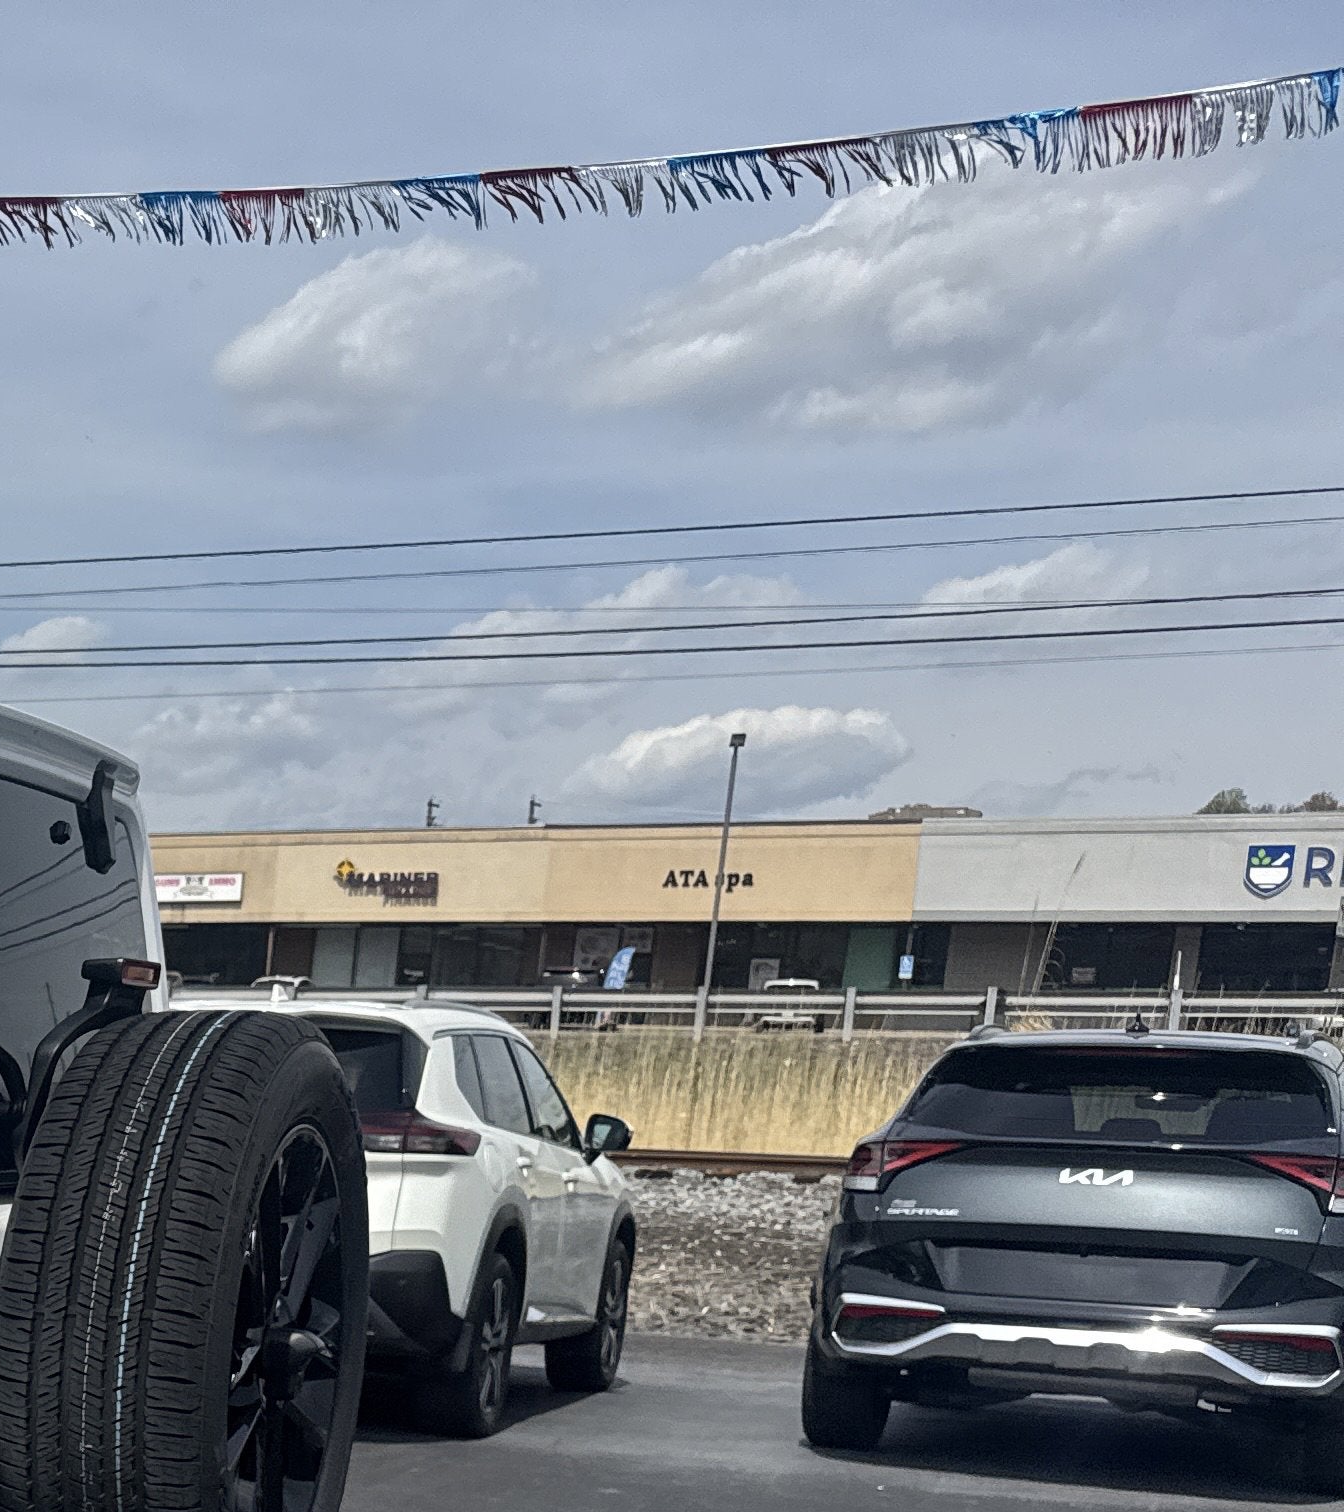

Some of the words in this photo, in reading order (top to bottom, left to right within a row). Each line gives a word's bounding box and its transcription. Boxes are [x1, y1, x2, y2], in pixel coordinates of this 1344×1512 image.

[346, 871, 439, 887] MARINER
[662, 870, 709, 888] ATA
[1059, 1168, 1134, 1187] KIA
